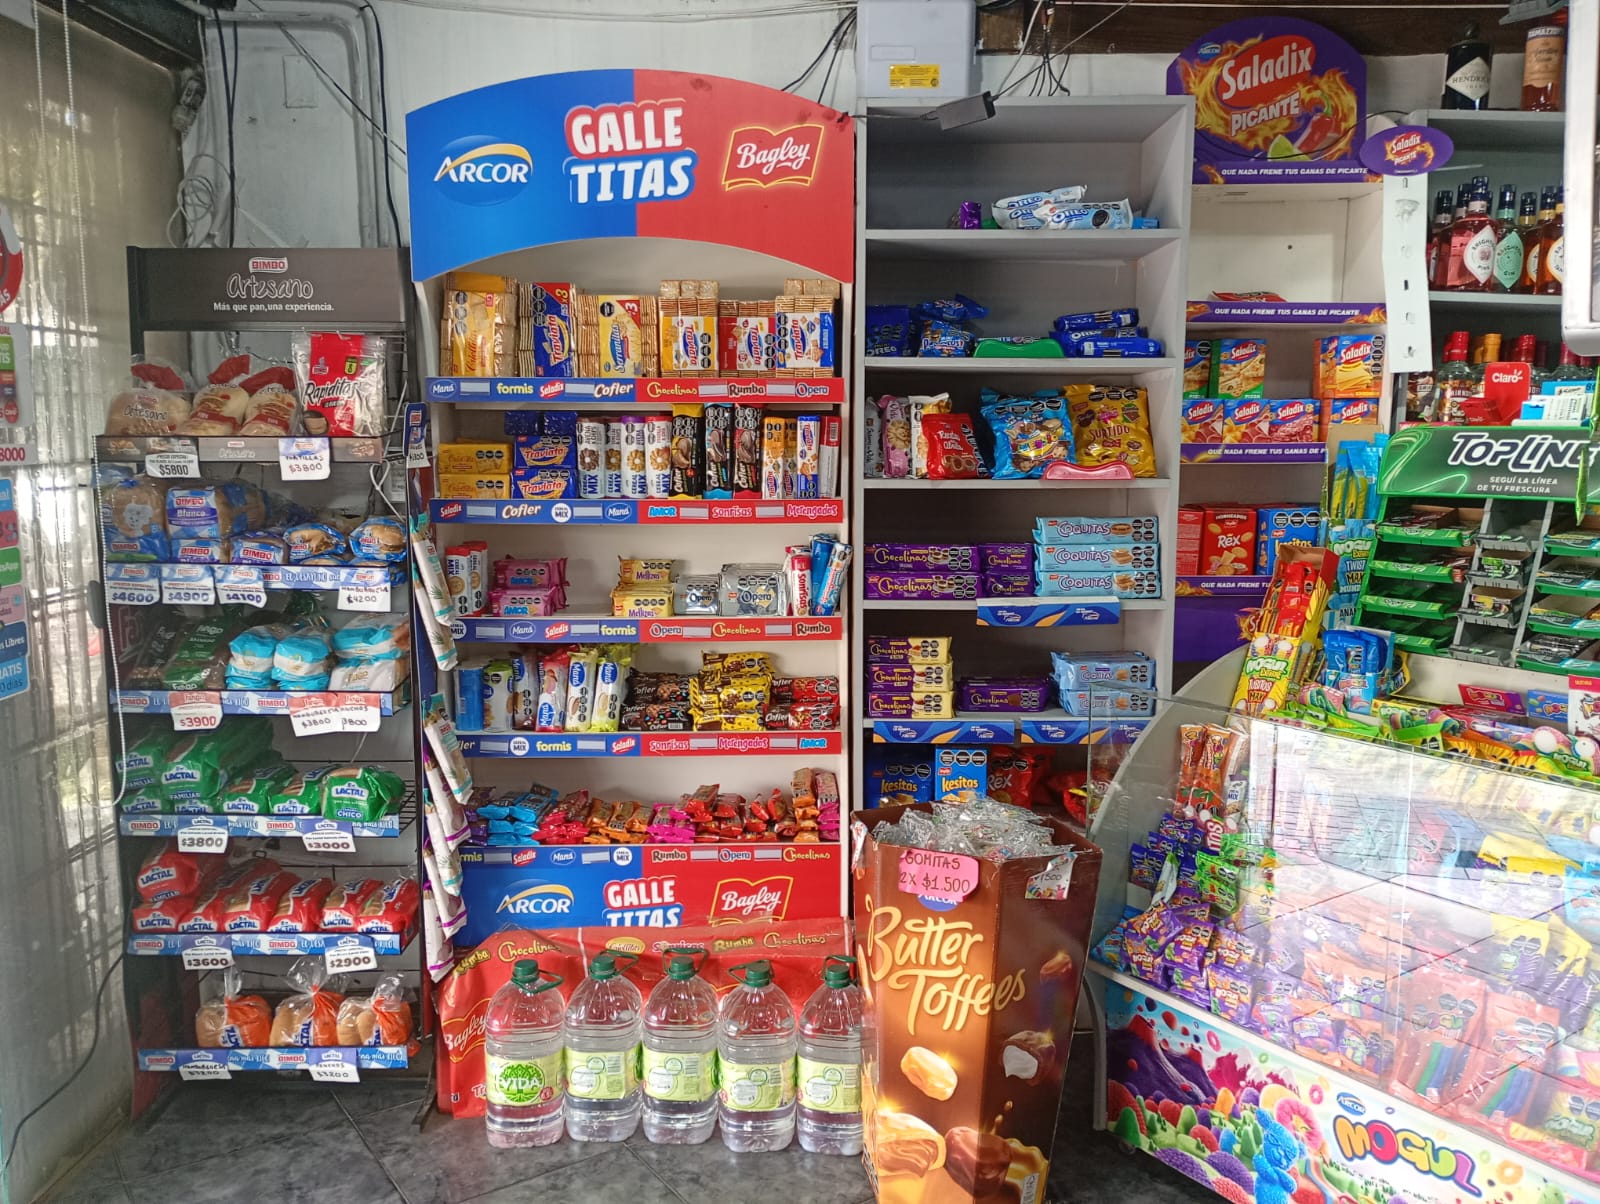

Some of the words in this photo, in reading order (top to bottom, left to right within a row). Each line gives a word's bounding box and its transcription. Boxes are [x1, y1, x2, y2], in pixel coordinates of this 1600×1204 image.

[1222, 42, 1312, 100] Saladix
[1231, 93, 1300, 136] PICANTE
[571, 106, 684, 153] GALLE
[1392, 134, 1421, 152] Saladix
[736, 138, 811, 175] Bagley
[433, 155, 529, 184] ARCOR
[570, 157, 692, 203] TITAS
[252, 260, 285, 270] BIMBO
[227, 273, 313, 299] Artesano
[213, 302, 231, 311] Más
[232, 304, 247, 313] que
[285, 302, 334, 313] experiencia.
[1214, 308, 1229, 316] QUE
[1231, 308, 1251, 316] NADA
[1231, 342, 1256, 359] Saladix
[1340, 342, 1371, 363] Saladix
[1492, 372, 1518, 383] Claro
[497, 383, 533, 394] formis
[540, 382, 564, 397] Saladix
[593, 384, 634, 398] Cofler
[647, 382, 697, 398] Chocolinas
[729, 384, 765, 395] Rumba
[796, 384, 829, 396] Opera
[1188, 403, 1213, 419] Saladix
[1234, 403, 1260, 419] Saladix
[1277, 403, 1304, 418] Saladix
[1341, 403, 1368, 418] Saladix
[525, 449, 565, 459] Traviata
[159, 465, 189, 476] $5800
[289, 463, 323, 473] $3800
[522, 482, 562, 492] Traviata
[588, 474, 598, 494] MIX
[662, 473, 671, 494] MIX
[1490, 475, 1516, 484] SEGUÍ
[1531, 475, 1558, 485] LÍNEA
[1491, 485, 1502, 493] TU
[1504, 485, 1551, 493] FRESCURA
[176, 497, 204, 506] BIMBO
[440, 504, 462, 517] Saladix
[502, 504, 542, 519] Cofler
[648, 506, 677, 517] AMOR
[1057, 521, 1110, 536] COQUITAS
[181, 547, 209, 556] BIMBO
[242, 548, 272, 559] BIMBO
[874, 549, 928, 565] Chocolinas
[1055, 547, 1109, 563] COQUITAS
[878, 577, 932, 593] Chocolinas
[1058, 575, 1112, 591] COQUITAS
[111, 591, 154, 602] $4600
[167, 591, 209, 602] $4900
[226, 593, 262, 605] $4100
[741, 591, 772, 602] Opera
[504, 606, 529, 615] AMOR
[545, 623, 569, 639] Saladix
[600, 626, 637, 636] formis
[651, 623, 682, 635] Opera
[712, 622, 761, 636] Chocolinas
[797, 624, 831, 634] Rumba
[179, 716, 217, 727] $3900
[535, 741, 572, 752] formis
[612, 738, 636, 753] Saladix
[800, 738, 827, 748] AMOR
[164, 770, 197, 781] LACTAL
[880, 779, 918, 793] kesitas
[942, 777, 979, 790] kesitas
[335, 787, 366, 798] LACTAL
[226, 803, 256, 811] LACTAL
[336, 810, 362, 818] CHICO
[131, 822, 160, 830] BIMBO
[181, 837, 224, 848] $3800
[307, 841, 349, 851] $3000
[513, 851, 536, 865] Saladix
[652, 850, 687, 862] Rumba
[720, 849, 750, 862] Opera
[783, 848, 830, 862] Chocolinas
[140, 869, 174, 885] LACTAL
[922, 875, 971, 894] $1.500
[607, 879, 675, 908] GALLE
[496, 895, 570, 913] ARCOR
[722, 887, 782, 915] Bagley
[140, 916, 172, 927] LACTAL
[181, 921, 213, 932] LACTAL
[228, 919, 258, 930] LACTAL
[322, 917, 352, 928] LACTAL
[135, 940, 162, 948] BIMBO
[763, 932, 827, 948] Chocolinas
[866, 896, 983, 981] Butter
[186, 957, 229, 967] $3600
[329, 956, 371, 967] $2900
[889, 968, 1026, 1035] Toffees
[279, 1055, 305, 1063] BIMBO
[1333, 1114, 1482, 1198] MOGUL
